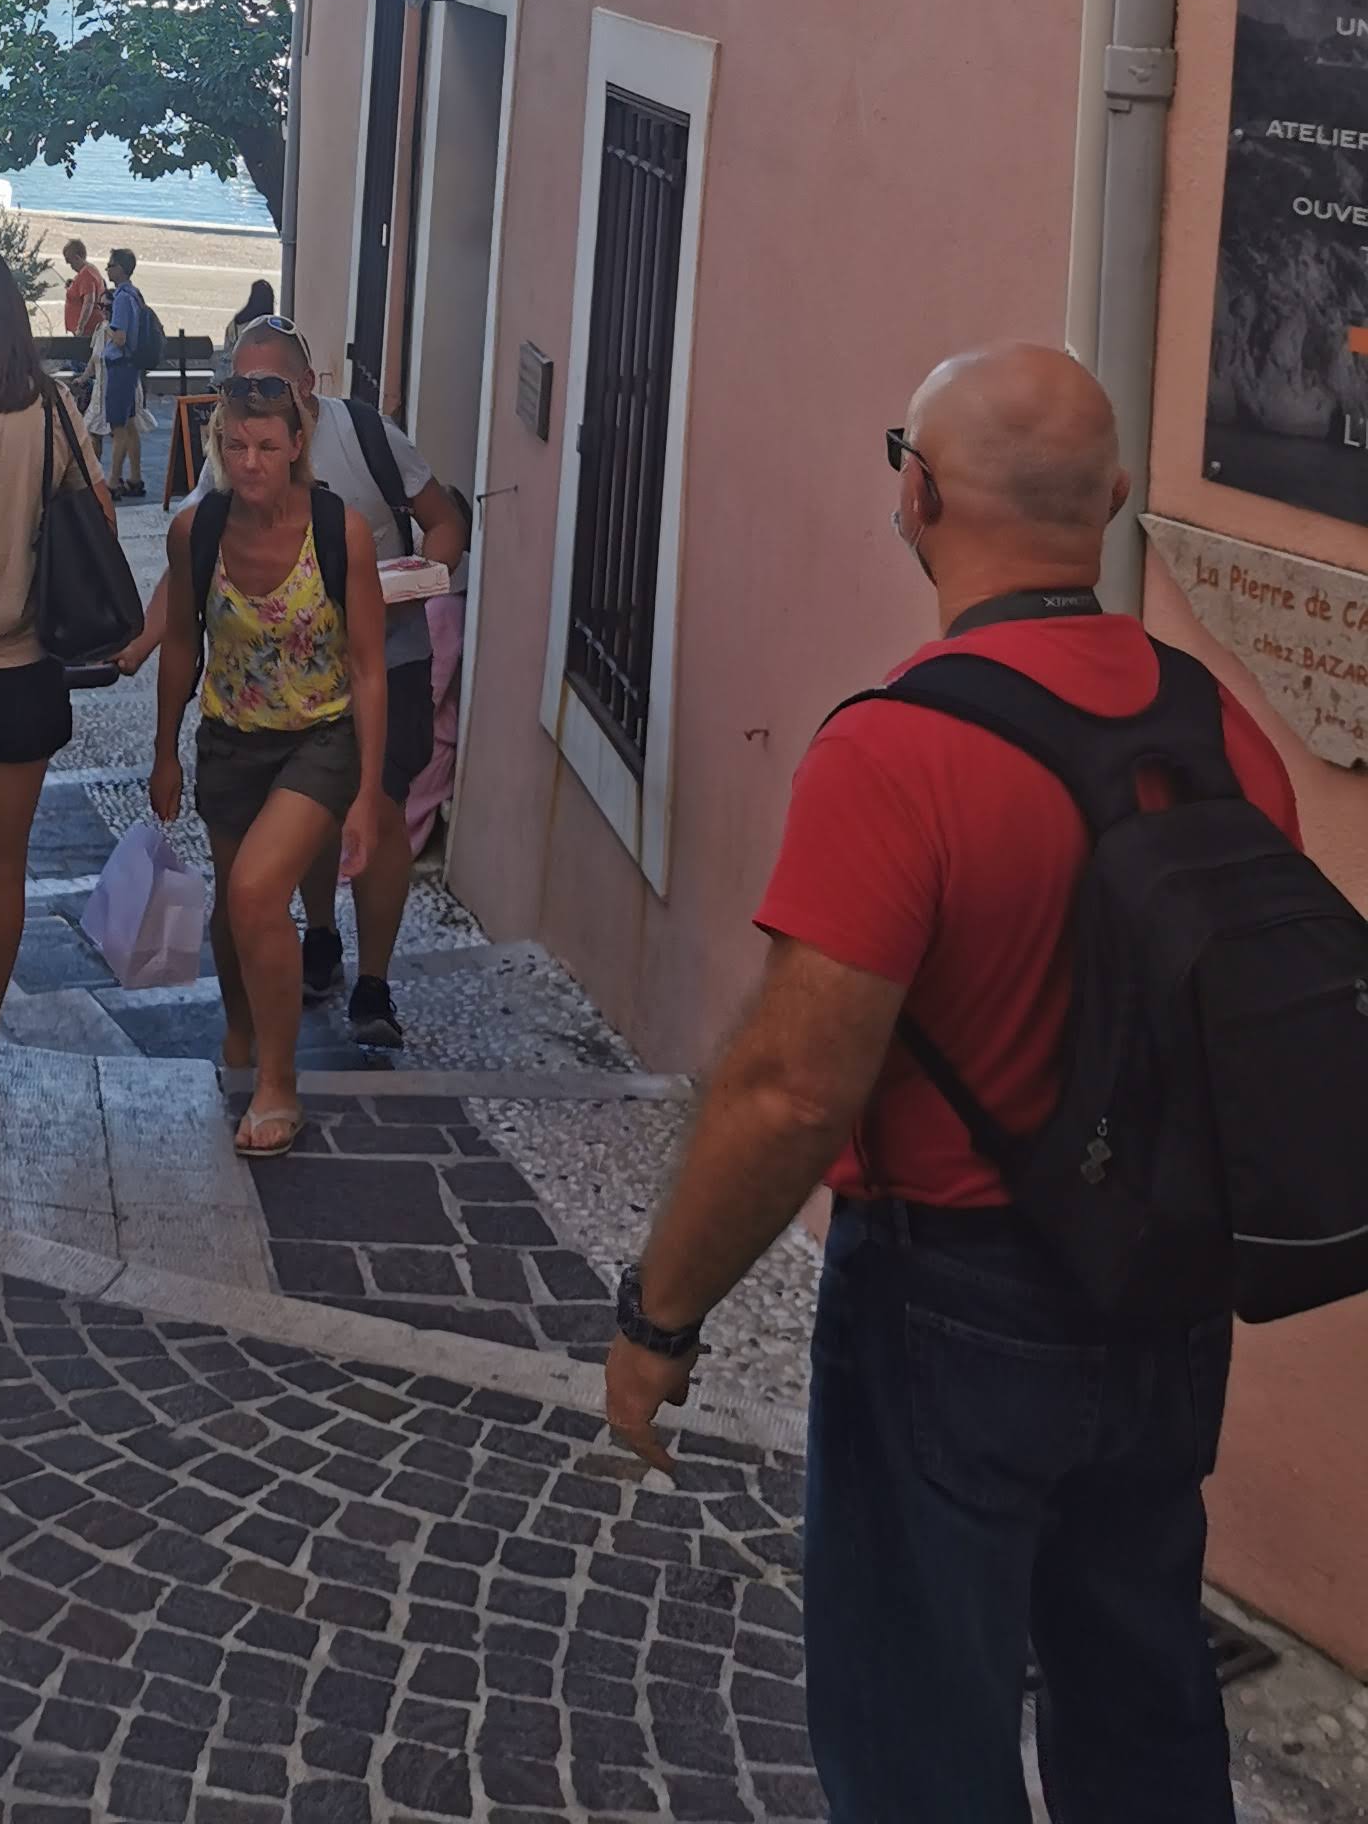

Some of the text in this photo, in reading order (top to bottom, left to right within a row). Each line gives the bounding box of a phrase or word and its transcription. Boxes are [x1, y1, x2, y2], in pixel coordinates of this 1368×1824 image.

[1195, 555, 1219, 588] La
[1229, 564, 1296, 610] Pierre
[1304, 586, 1332, 622] de
[1253, 632, 1294, 664] chez
